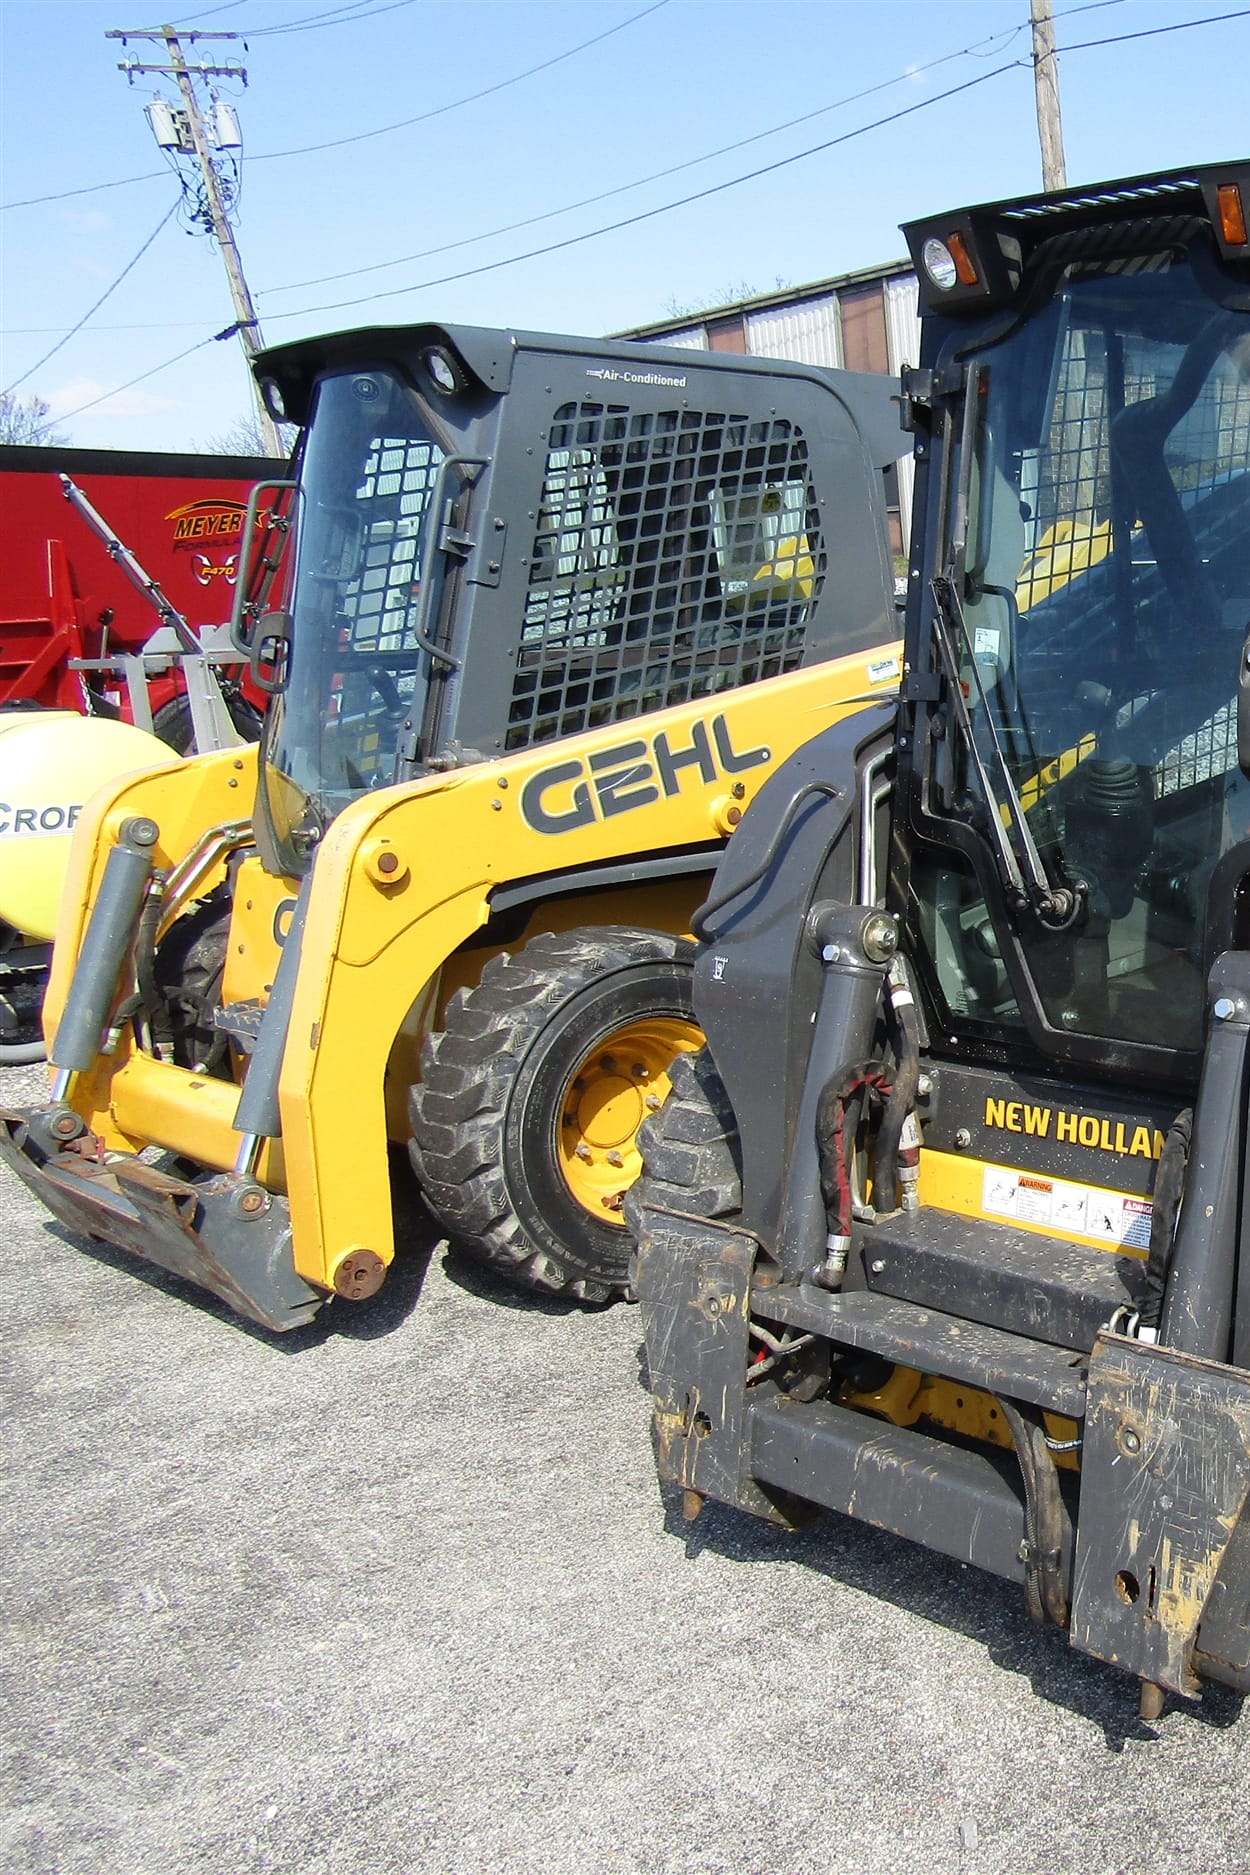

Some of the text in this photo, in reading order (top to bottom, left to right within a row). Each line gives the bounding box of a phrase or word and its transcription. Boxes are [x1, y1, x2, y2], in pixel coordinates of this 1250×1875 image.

[603, 368, 687, 387] Air-Conditioned
[173, 513, 243, 539] MEYER
[201, 566, 235, 577] F470
[519, 712, 772, 836] GEHL
[985, 1097, 1168, 1160] NEW HOLLAN
[1025, 1180, 1053, 1192] WARNING
[1132, 1203, 1153, 1214] DANGE
